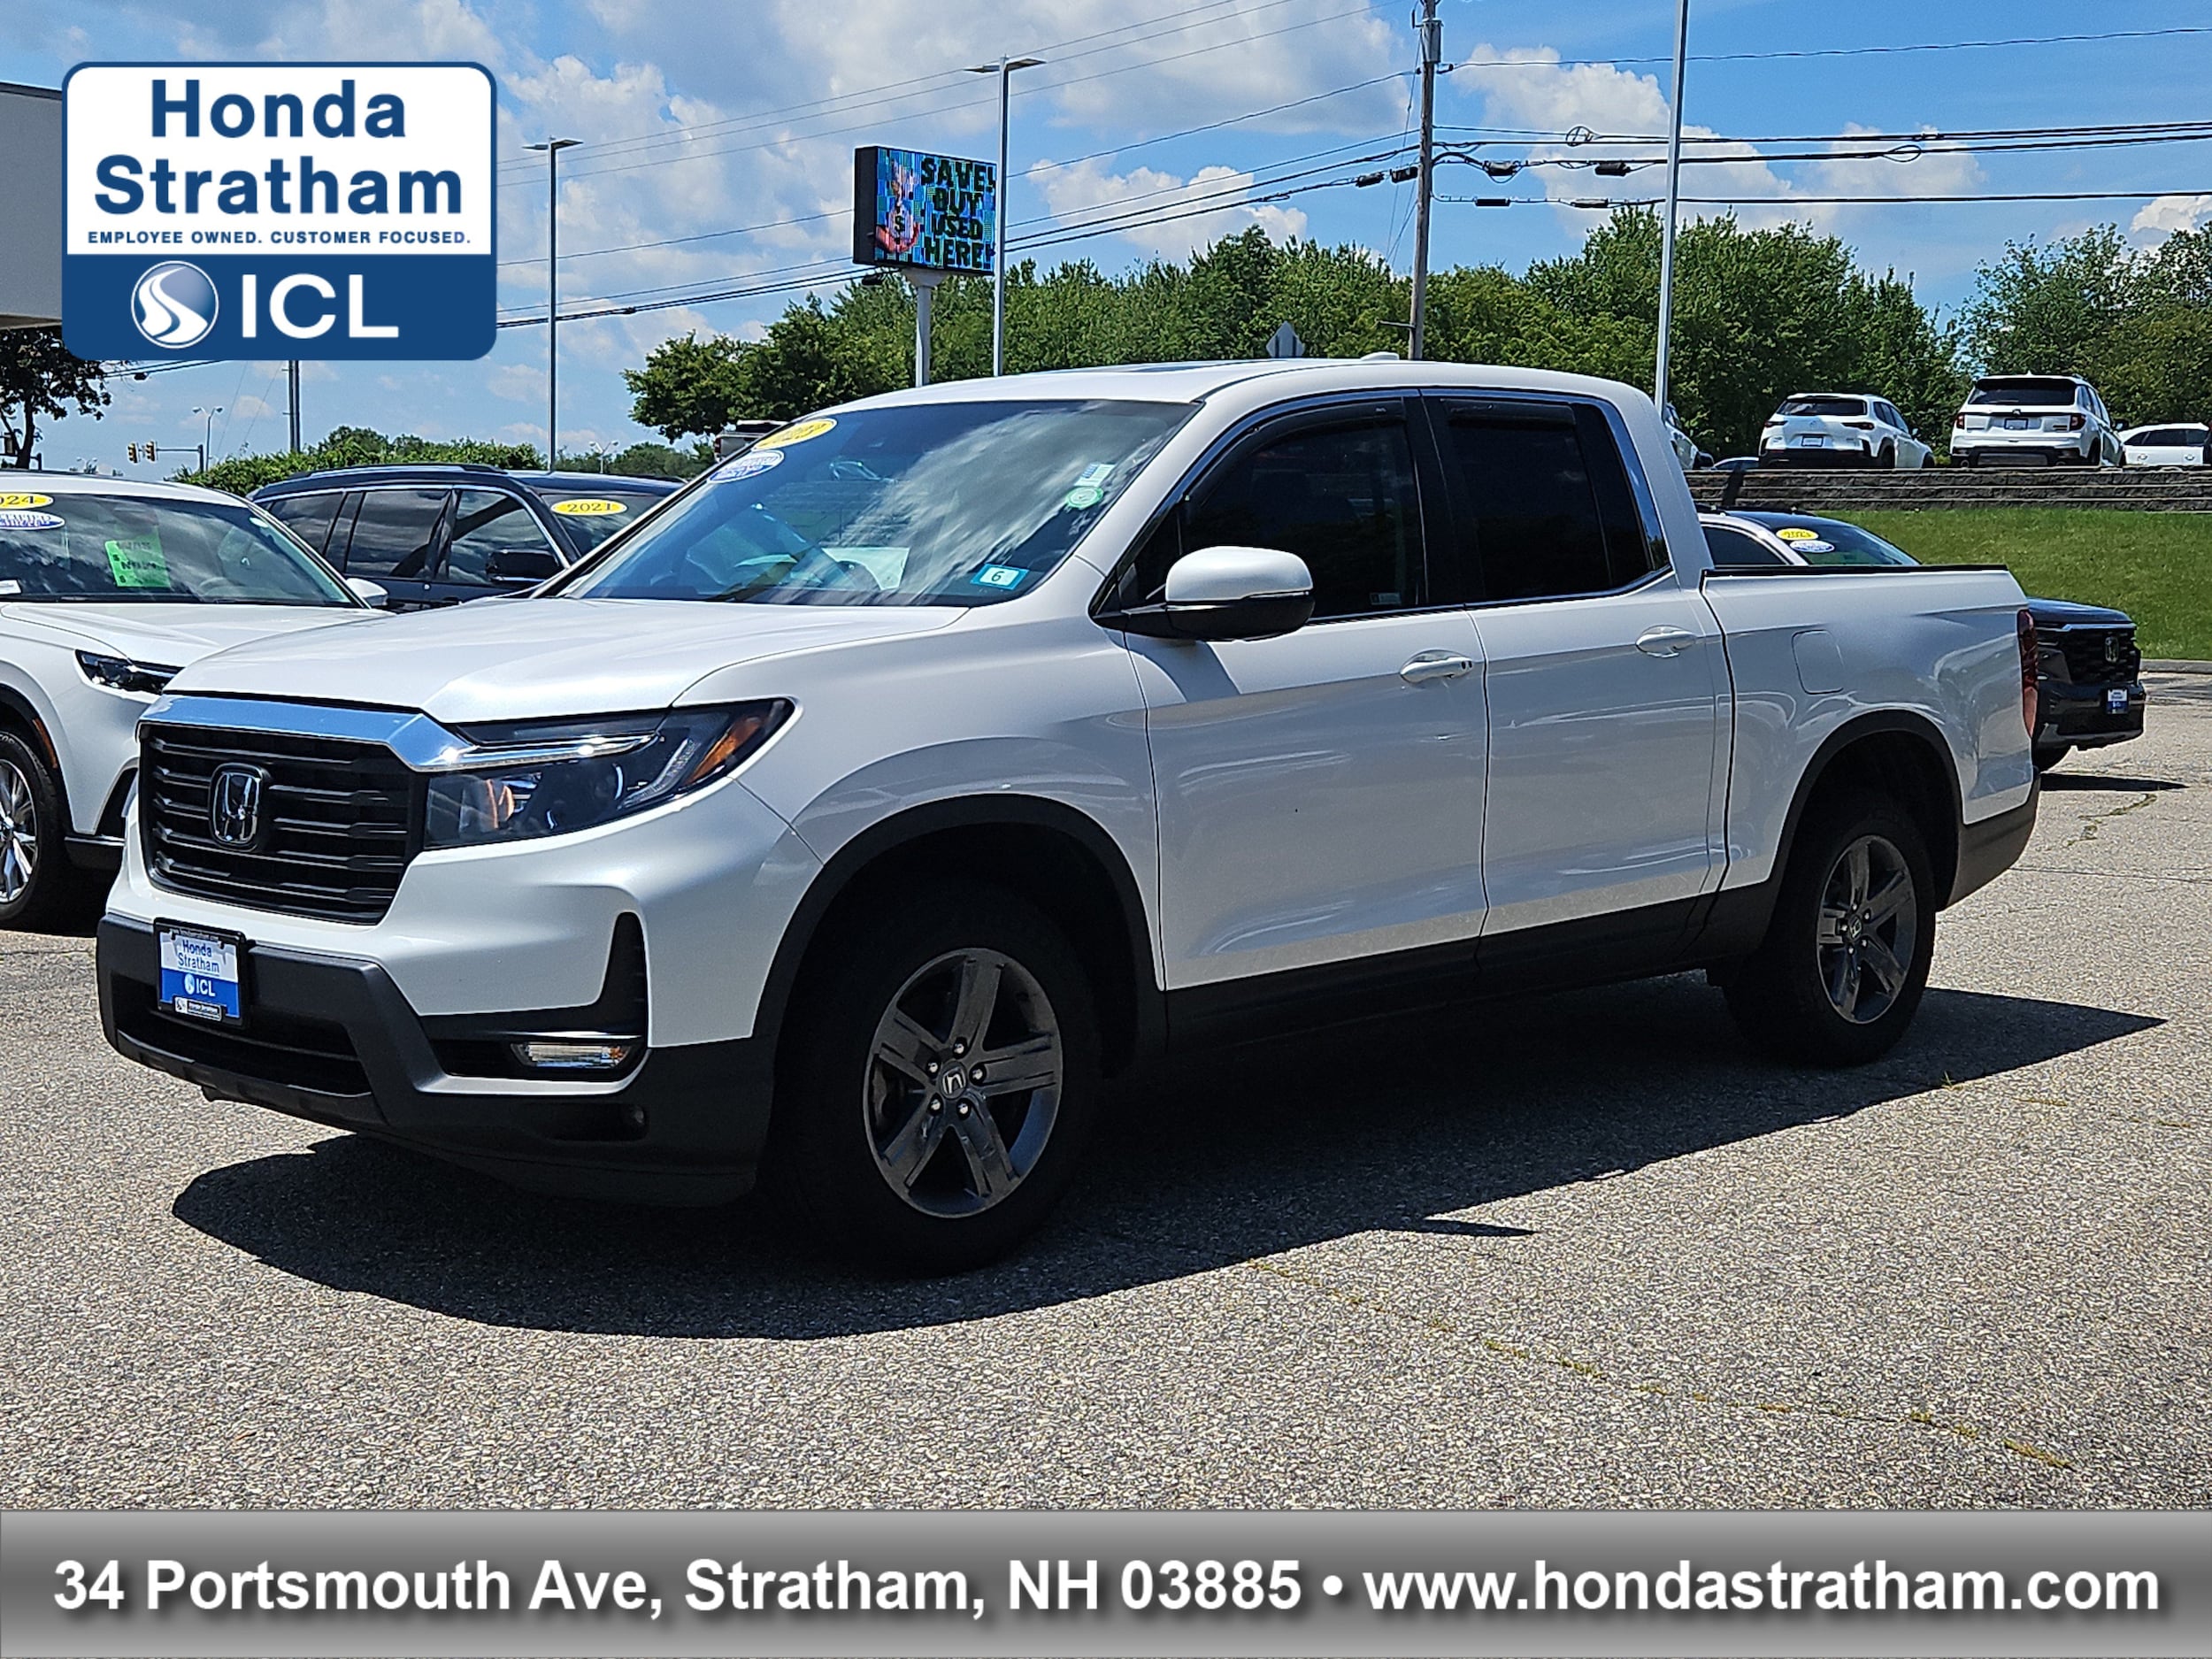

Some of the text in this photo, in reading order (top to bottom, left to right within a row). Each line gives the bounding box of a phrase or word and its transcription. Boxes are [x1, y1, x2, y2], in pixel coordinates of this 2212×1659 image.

[921, 157, 995, 192] SAVE!
[933, 187, 983, 218] BUY
[932, 212, 984, 241] USED
[925, 236, 993, 269] HERE!
[567, 503, 611, 512] 2021
[992, 571, 1004, 581] 6
[182, 940, 212, 957] Honda
[178, 952, 220, 973] Stratham
[196, 978, 216, 997] ICL
